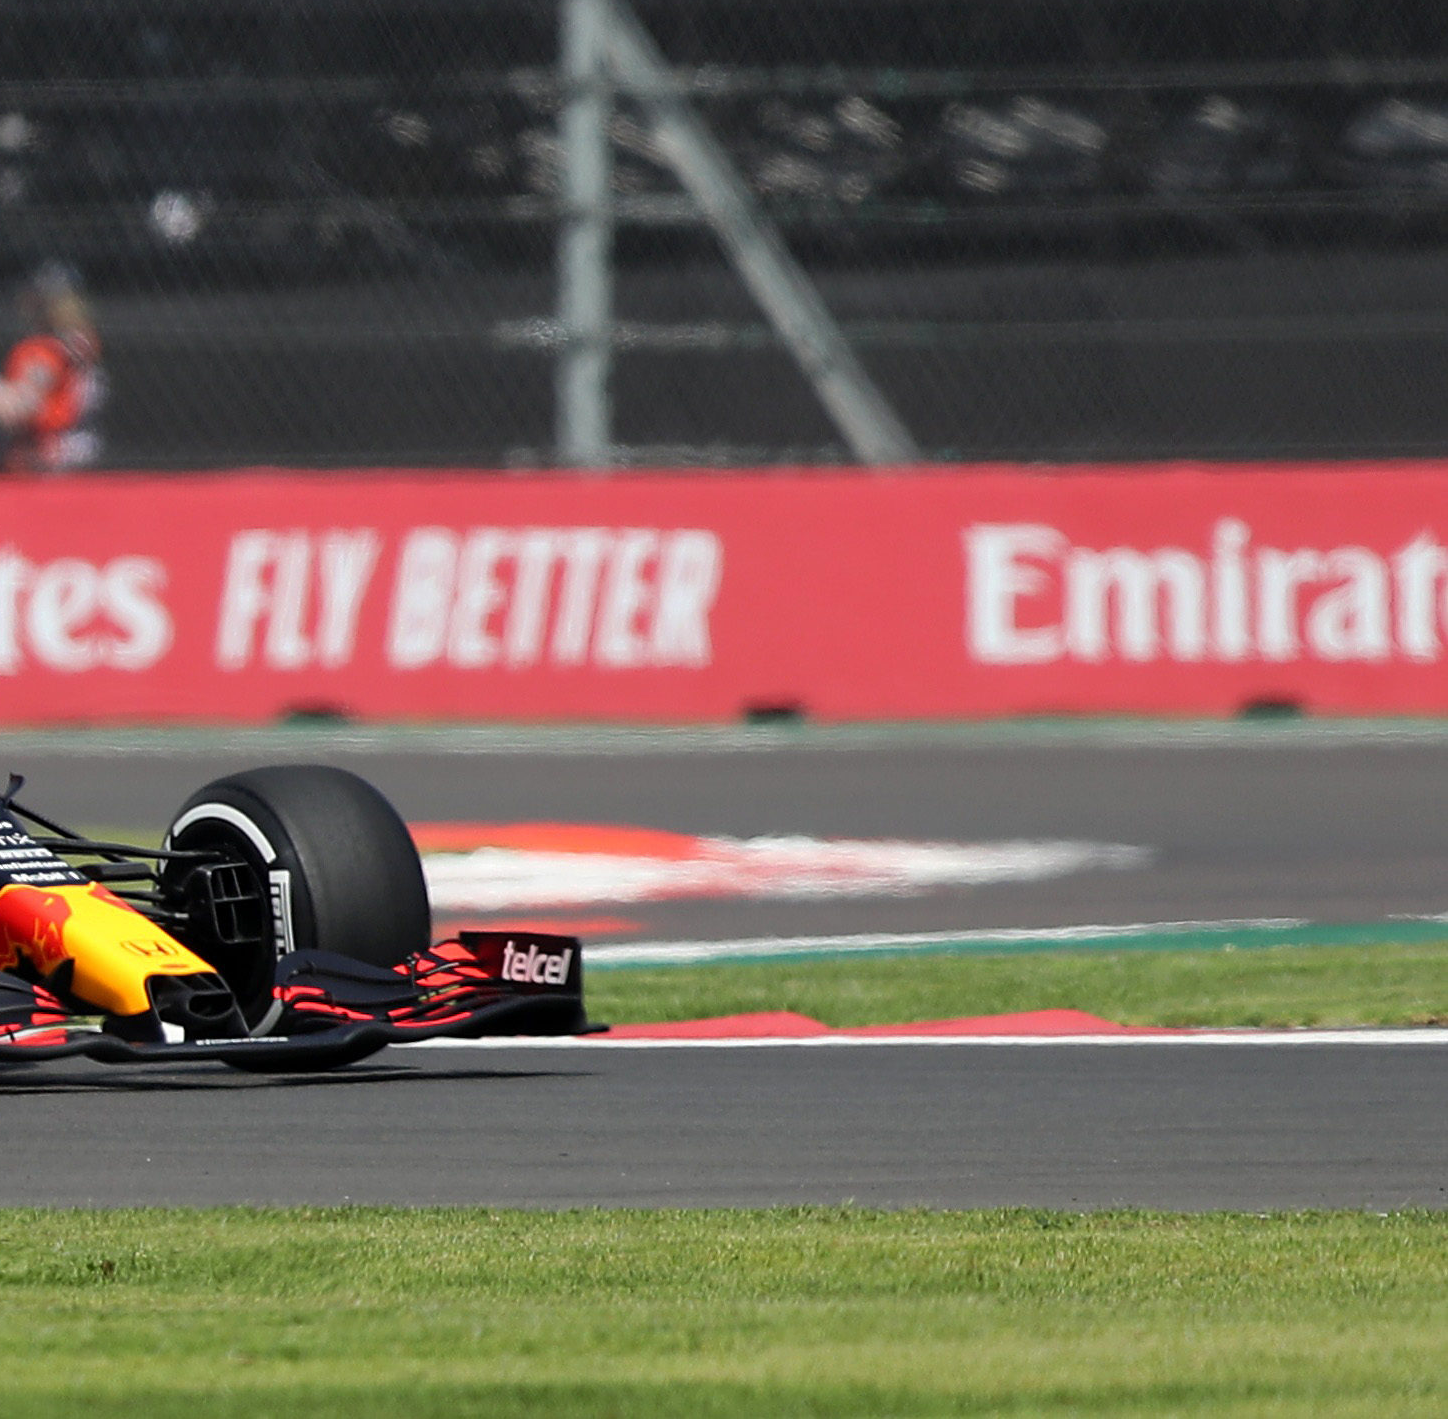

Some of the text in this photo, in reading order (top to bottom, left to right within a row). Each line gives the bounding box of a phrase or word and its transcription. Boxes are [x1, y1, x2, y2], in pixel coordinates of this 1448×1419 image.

[215, 526, 723, 670] FLY BETTER
[962, 517, 1448, 665] Emirat
[501, 940, 574, 986] telcel
